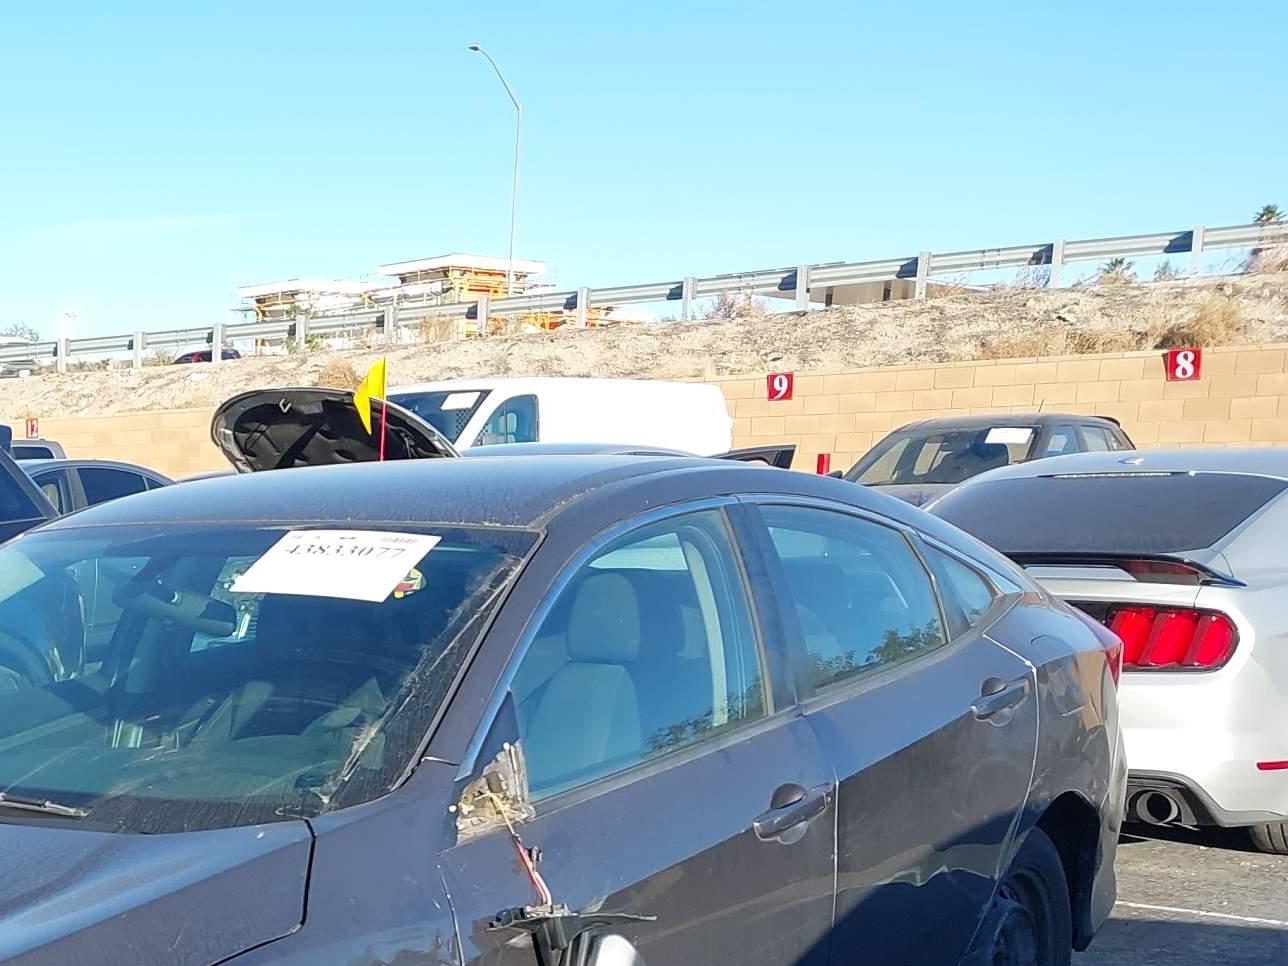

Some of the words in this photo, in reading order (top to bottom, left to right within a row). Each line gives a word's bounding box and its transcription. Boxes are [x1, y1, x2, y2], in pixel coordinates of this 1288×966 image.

[1175, 350, 1195, 379] 8
[773, 374, 789, 400] 9
[285, 544, 407, 558] 43833077
